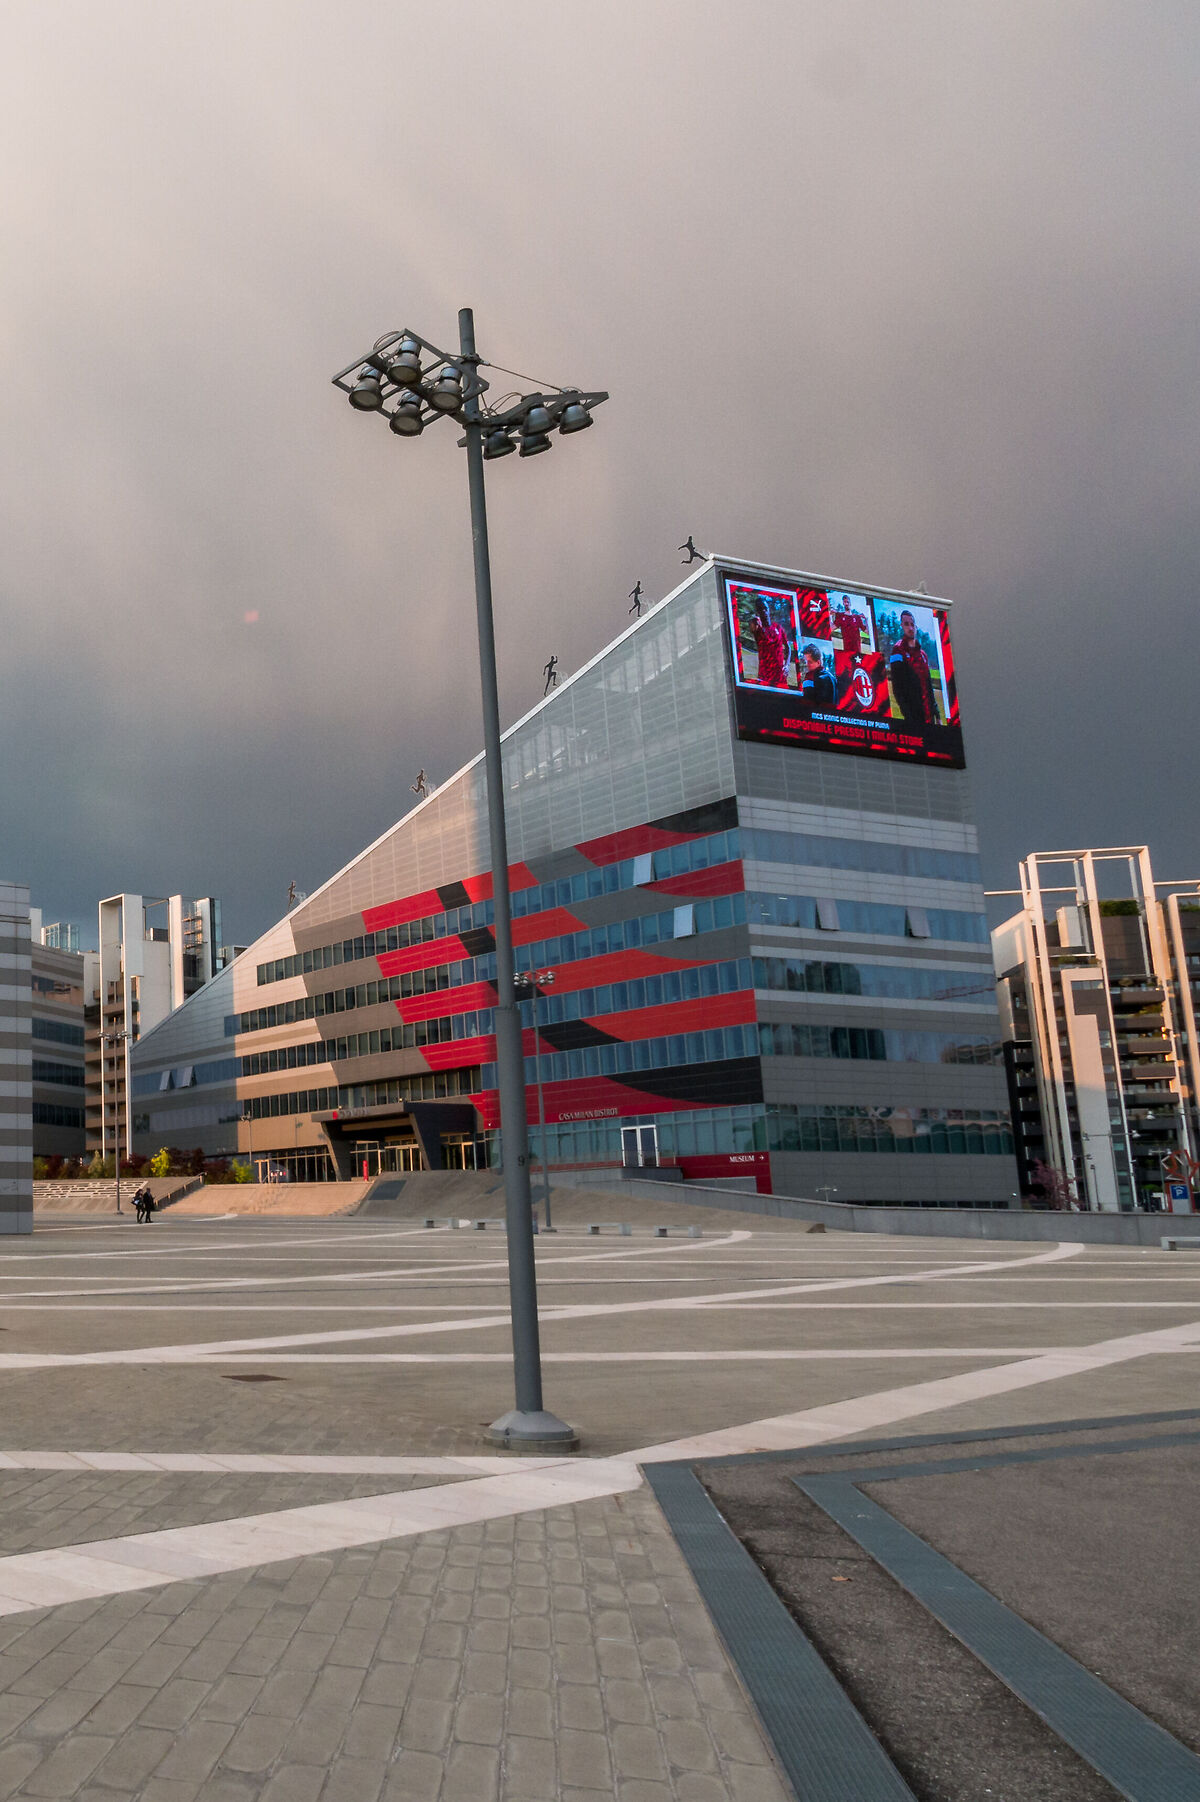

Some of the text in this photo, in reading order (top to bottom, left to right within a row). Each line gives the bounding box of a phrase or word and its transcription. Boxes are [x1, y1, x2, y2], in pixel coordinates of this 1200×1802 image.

[840, 716, 867, 727] COLLECTION
[875, 721, 890, 730] PUMA
[783, 717, 832, 735] DISPONIBILE
[834, 725, 865, 739] PRESSO
[871, 730, 898, 744] MILAN
[899, 734, 924, 747] STORE
[559, 1112, 574, 1121] CASA
[575, 1110, 594, 1119] MILAN
[729, 1154, 755, 1163] MUSEUM
